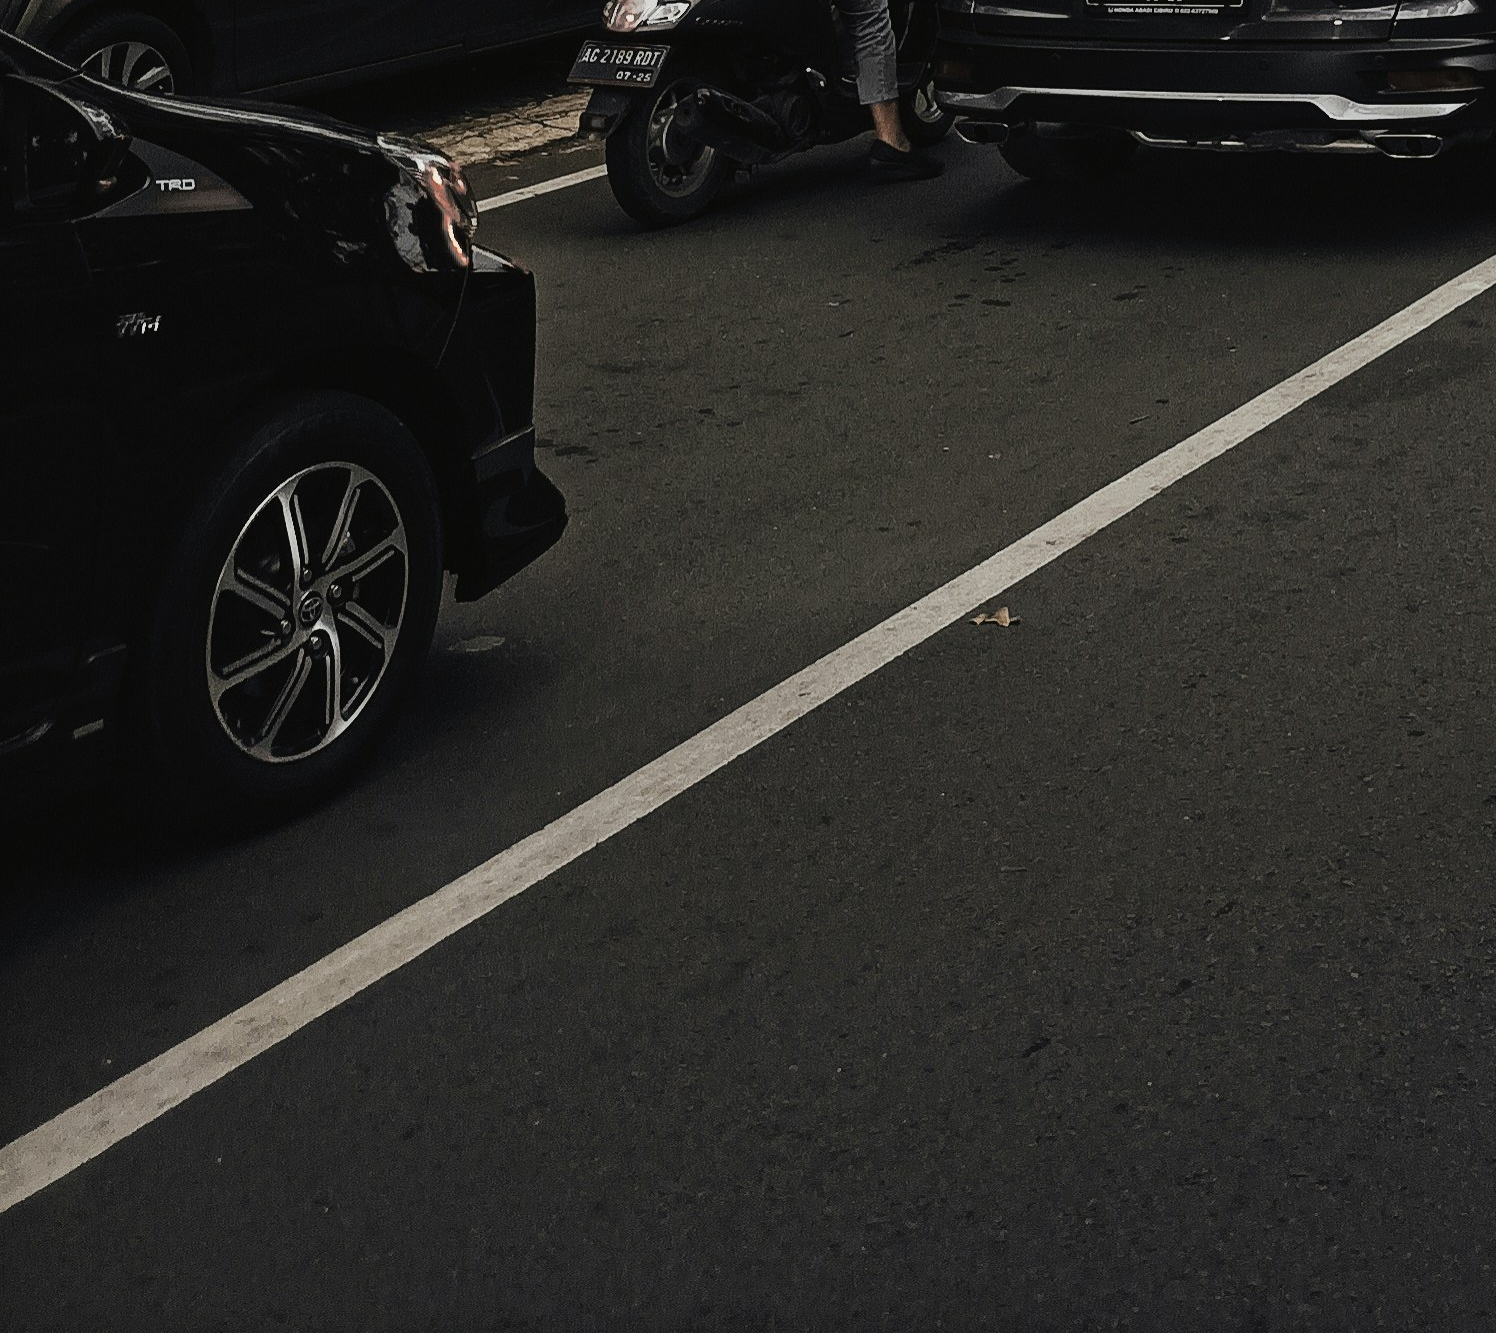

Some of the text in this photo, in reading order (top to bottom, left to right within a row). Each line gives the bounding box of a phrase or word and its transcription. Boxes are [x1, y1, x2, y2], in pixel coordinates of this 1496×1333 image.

[600, 49, 633, 65] 2189
[634, 50, 661, 66] RDT
[155, 178, 196, 192] TRD
